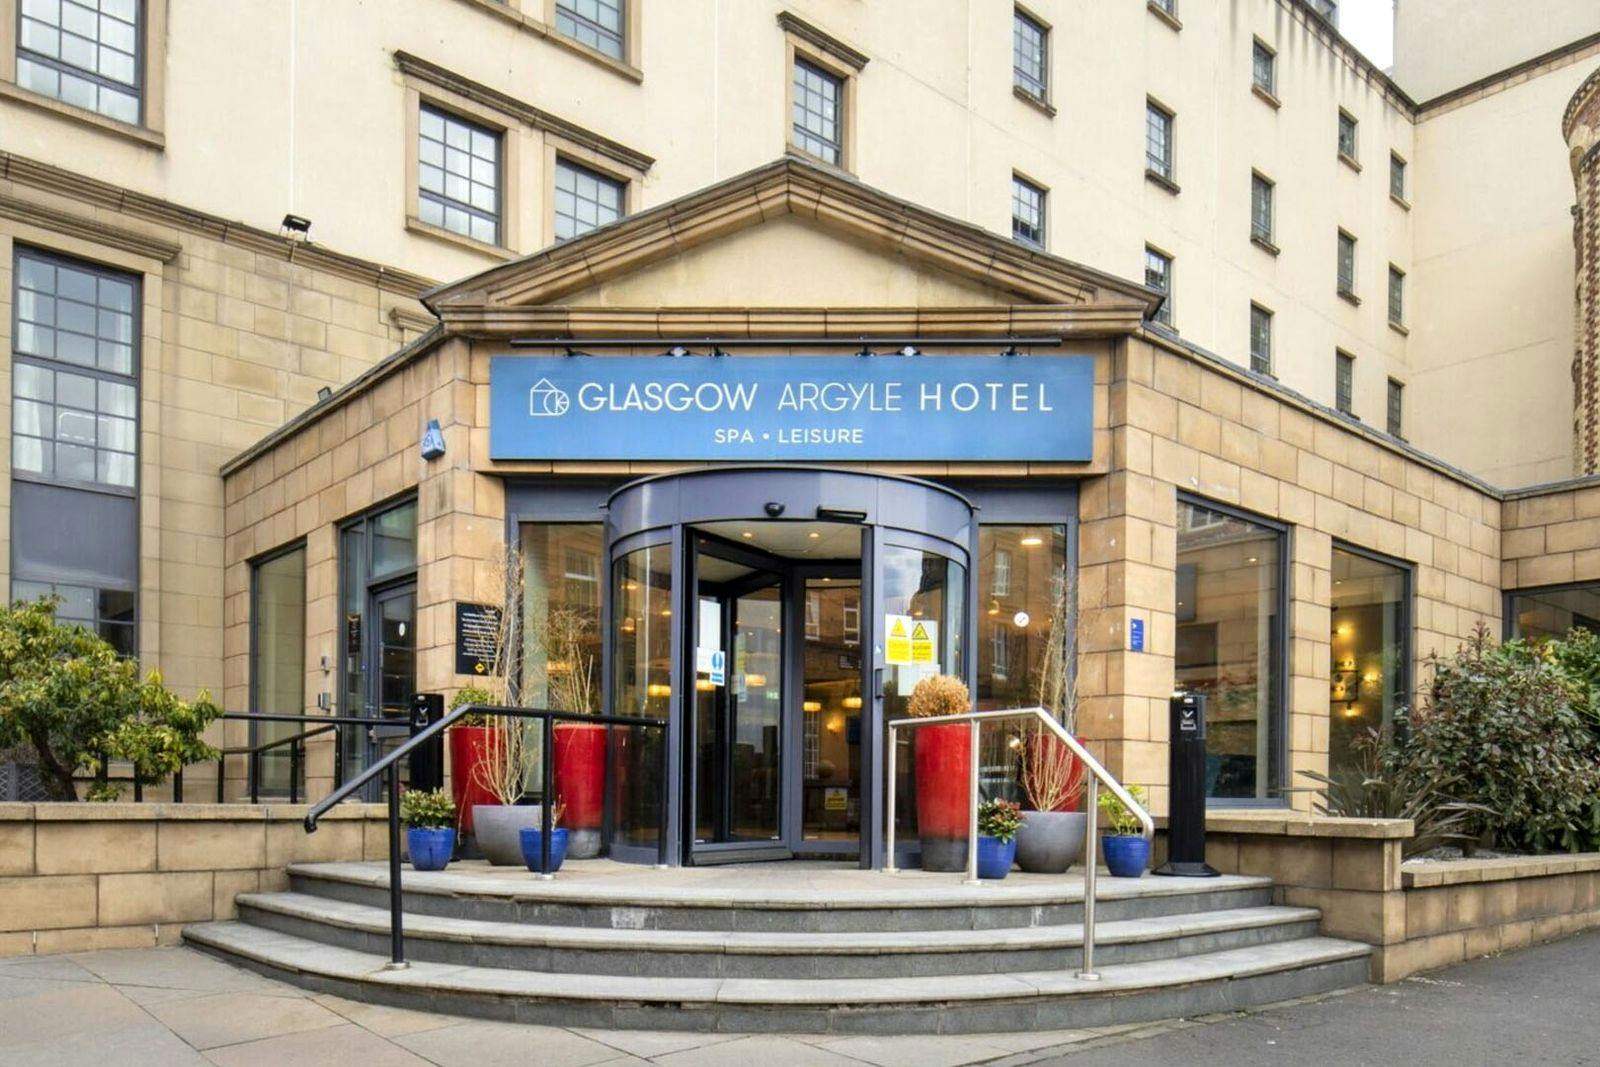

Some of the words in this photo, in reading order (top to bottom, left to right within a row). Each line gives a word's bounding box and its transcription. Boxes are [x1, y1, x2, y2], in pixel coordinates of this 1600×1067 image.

[578, 382, 758, 412] GLASGOW
[778, 382, 902, 412] ARGYLE
[920, 382, 1053, 412] HOTEL
[714, 428, 755, 444] SPA
[777, 428, 864, 444] LEISURE
